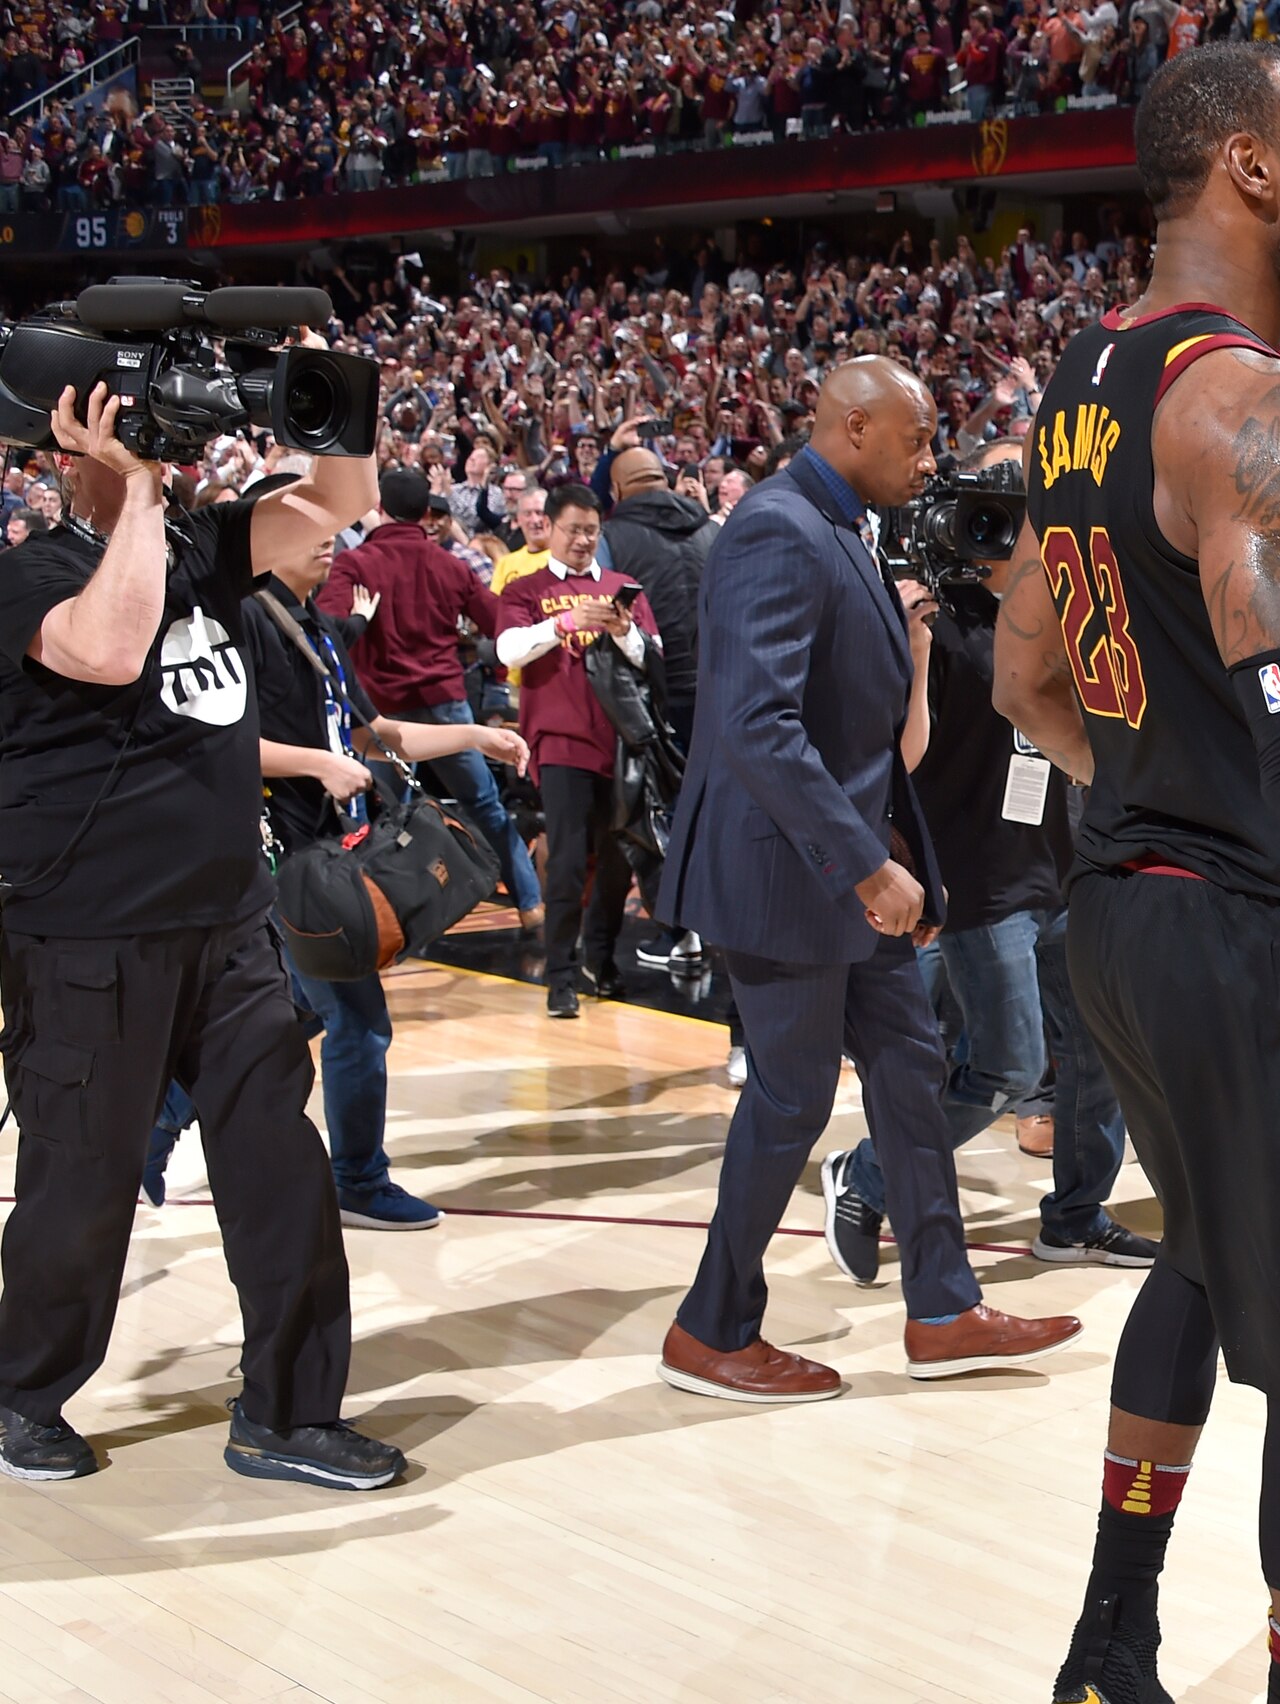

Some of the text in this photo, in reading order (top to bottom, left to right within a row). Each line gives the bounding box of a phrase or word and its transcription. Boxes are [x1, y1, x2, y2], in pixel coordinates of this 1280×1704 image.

[76, 217, 107, 248] 95
[166, 222, 178, 244] 3
[117, 350, 145, 360] SONY
[1038, 403, 1121, 490] JAMES
[1041, 526, 1147, 730] 23
